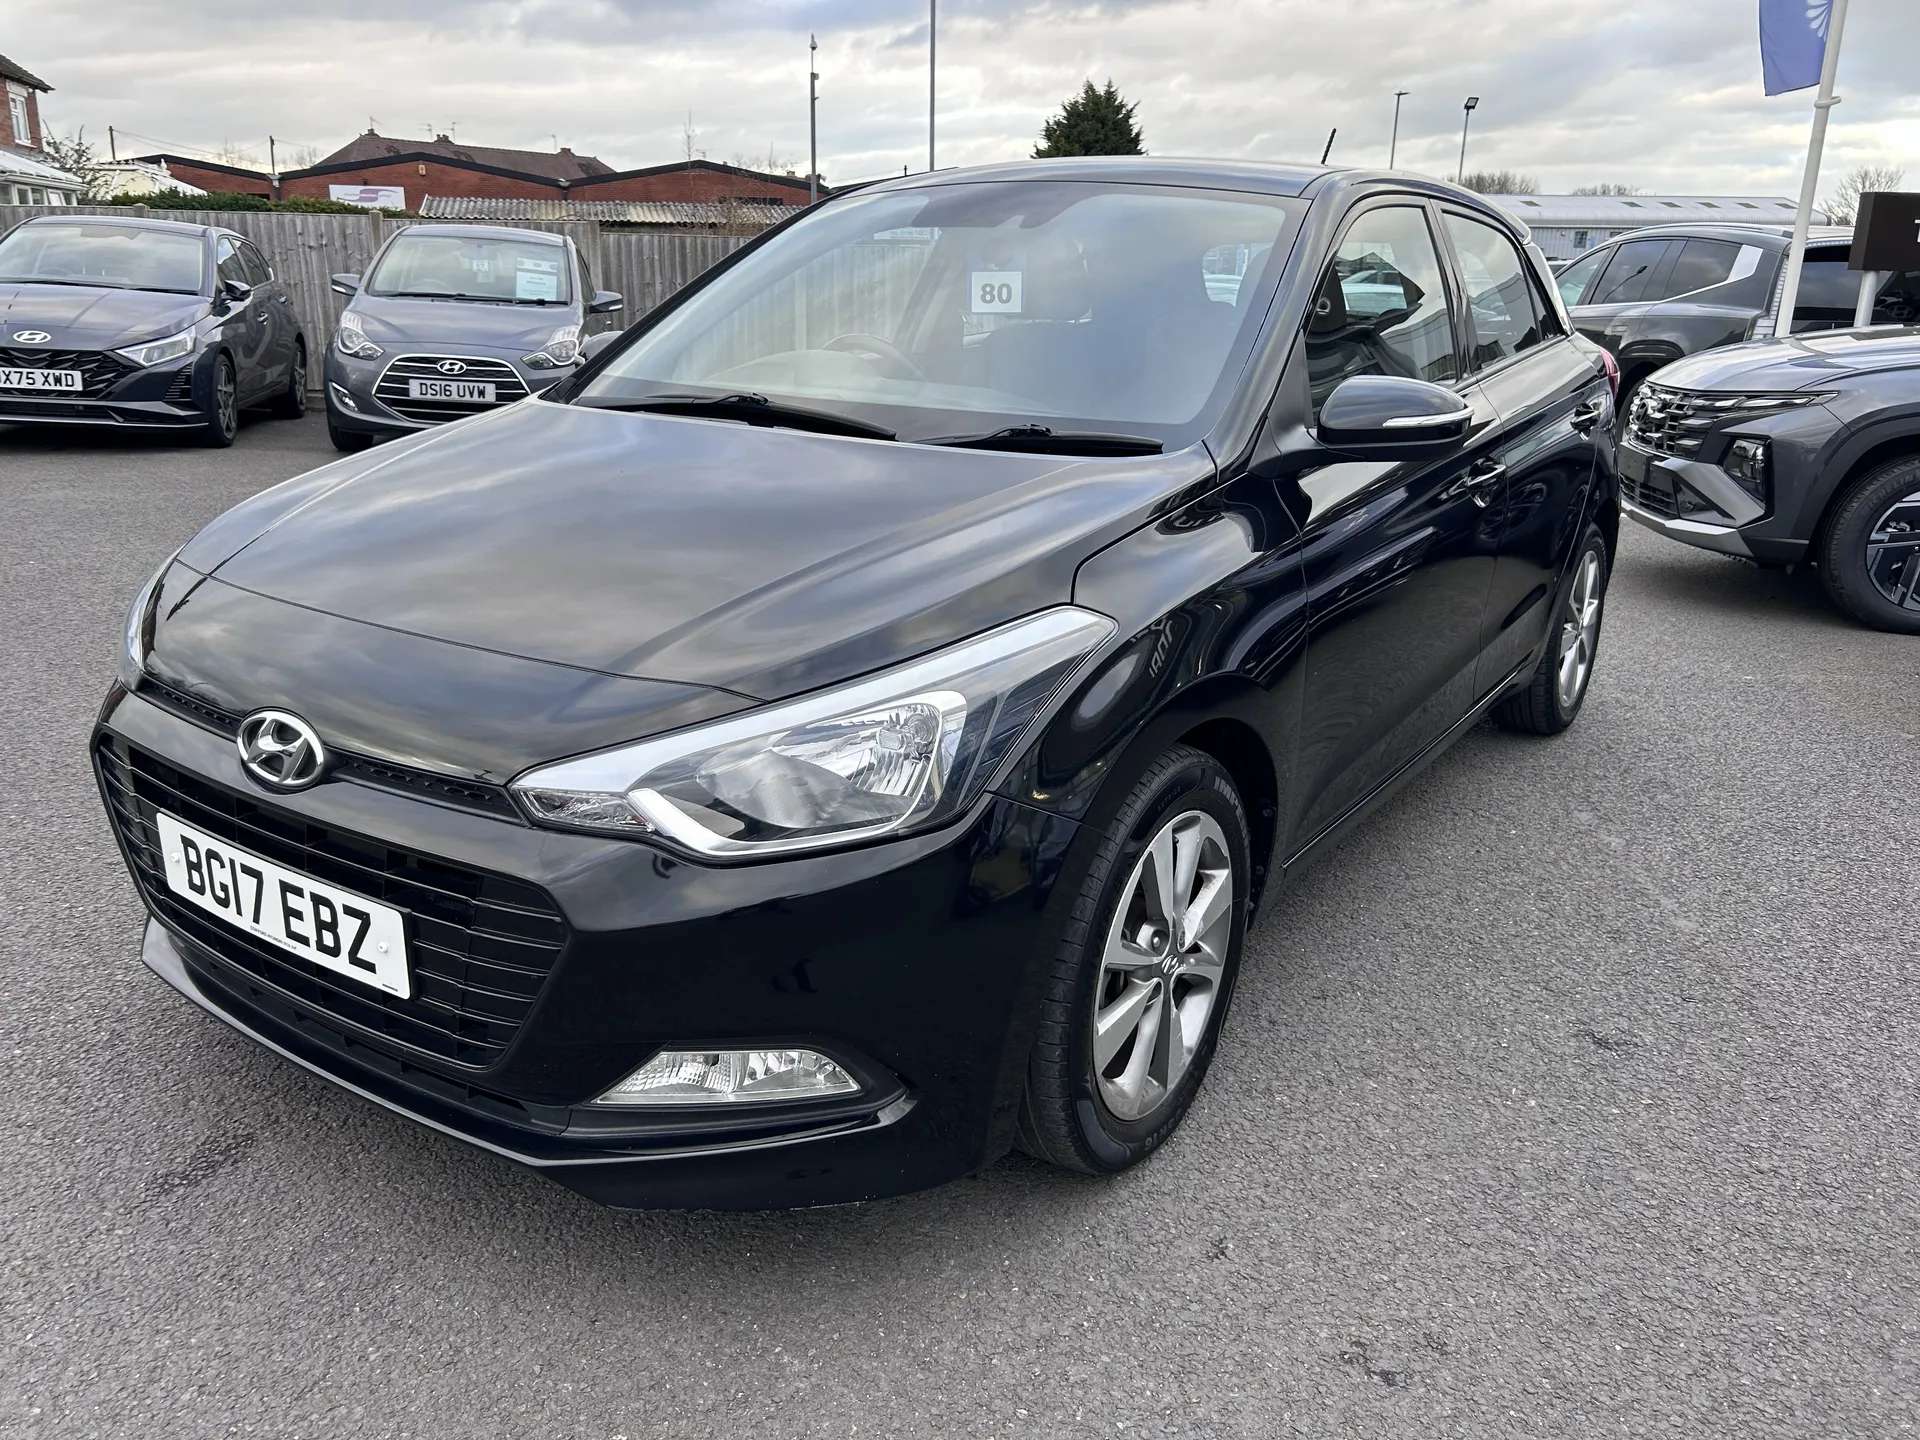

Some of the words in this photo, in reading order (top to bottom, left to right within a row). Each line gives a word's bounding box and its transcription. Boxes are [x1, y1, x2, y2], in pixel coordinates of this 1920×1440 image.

[980, 283, 1012, 304] 80
[0, 370, 35, 386] X75
[41, 372, 75, 387] XWD
[419, 382, 452, 397] DS16
[457, 385, 486, 399] UVW
[180, 834, 264, 925] BG17
[278, 879, 377, 975] EBZ
